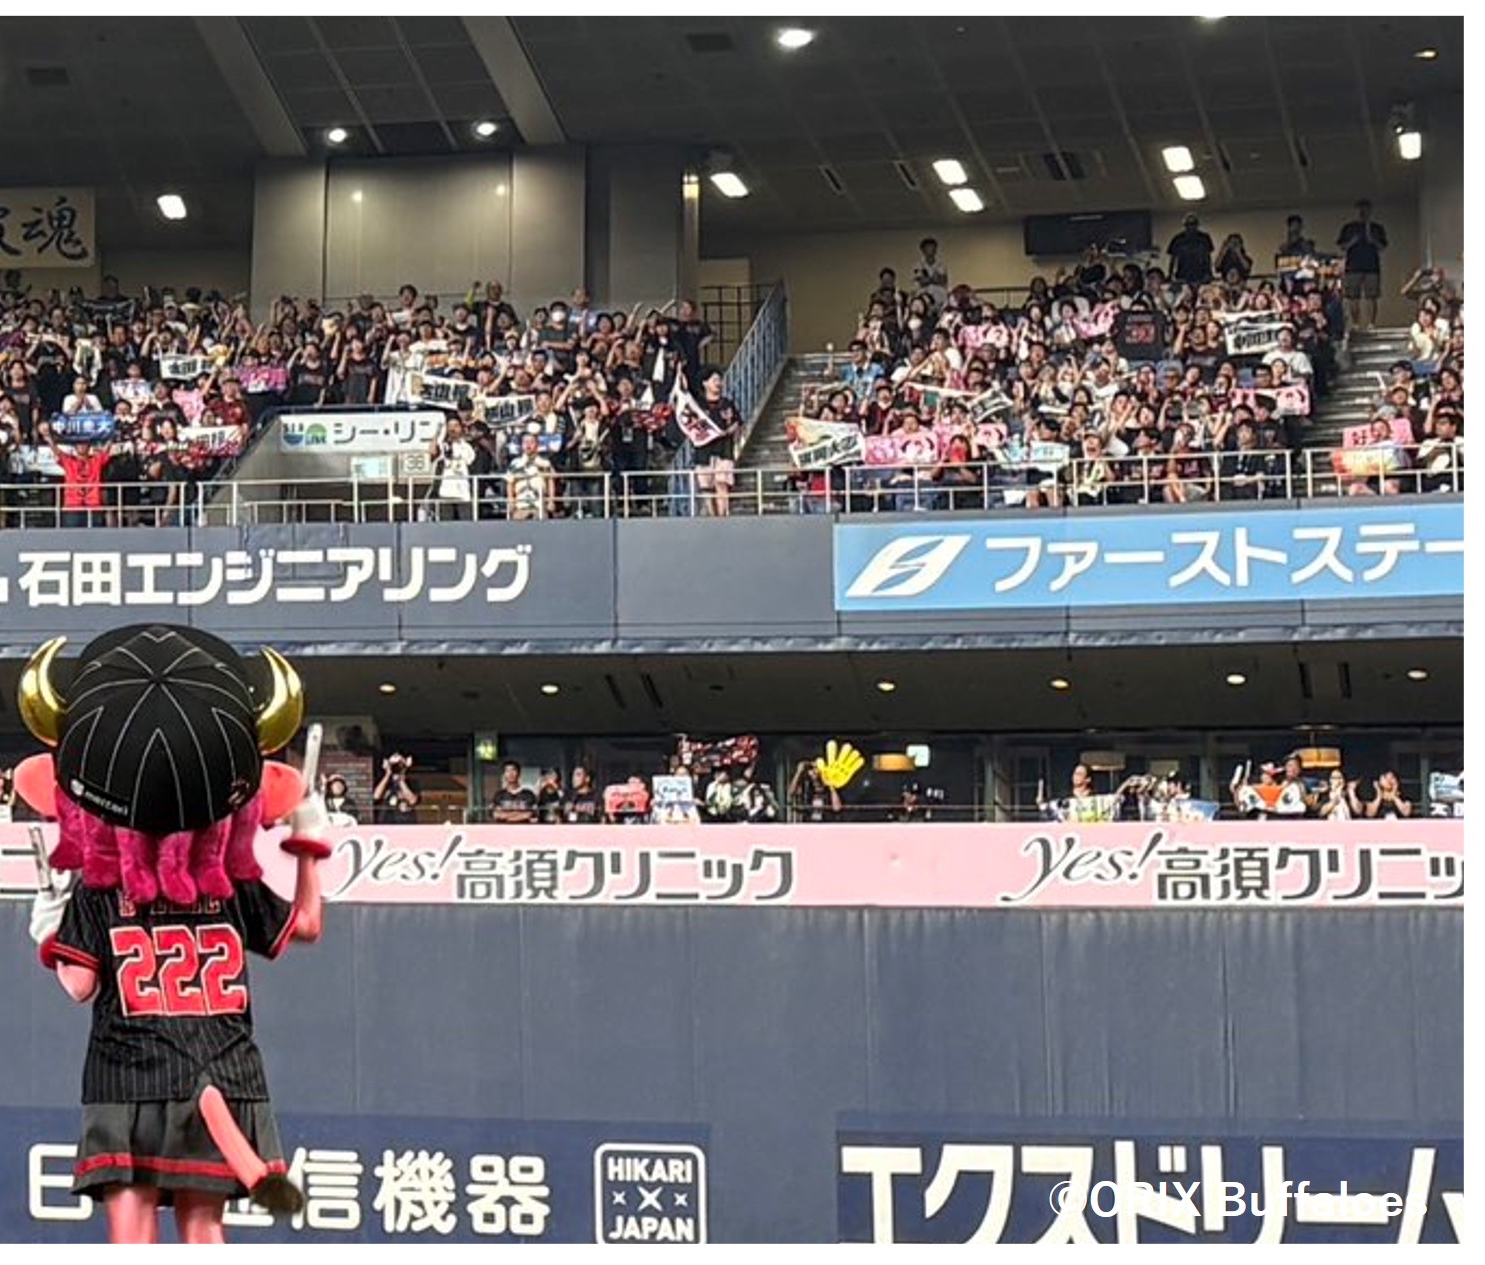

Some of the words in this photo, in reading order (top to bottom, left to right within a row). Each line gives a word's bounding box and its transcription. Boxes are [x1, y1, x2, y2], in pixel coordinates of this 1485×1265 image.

[17, 544, 533, 607] 石田エンジニアリング
[456, 847, 794, 902] 高須クリニック
[1154, 846, 1464, 902] 高須クリニッ
[109, 923, 249, 1017] 222
[28, 1143, 550, 1238] 日信機器
[608, 1157, 693, 1183] HIKARI
[607, 1214, 695, 1242] JAPAN
